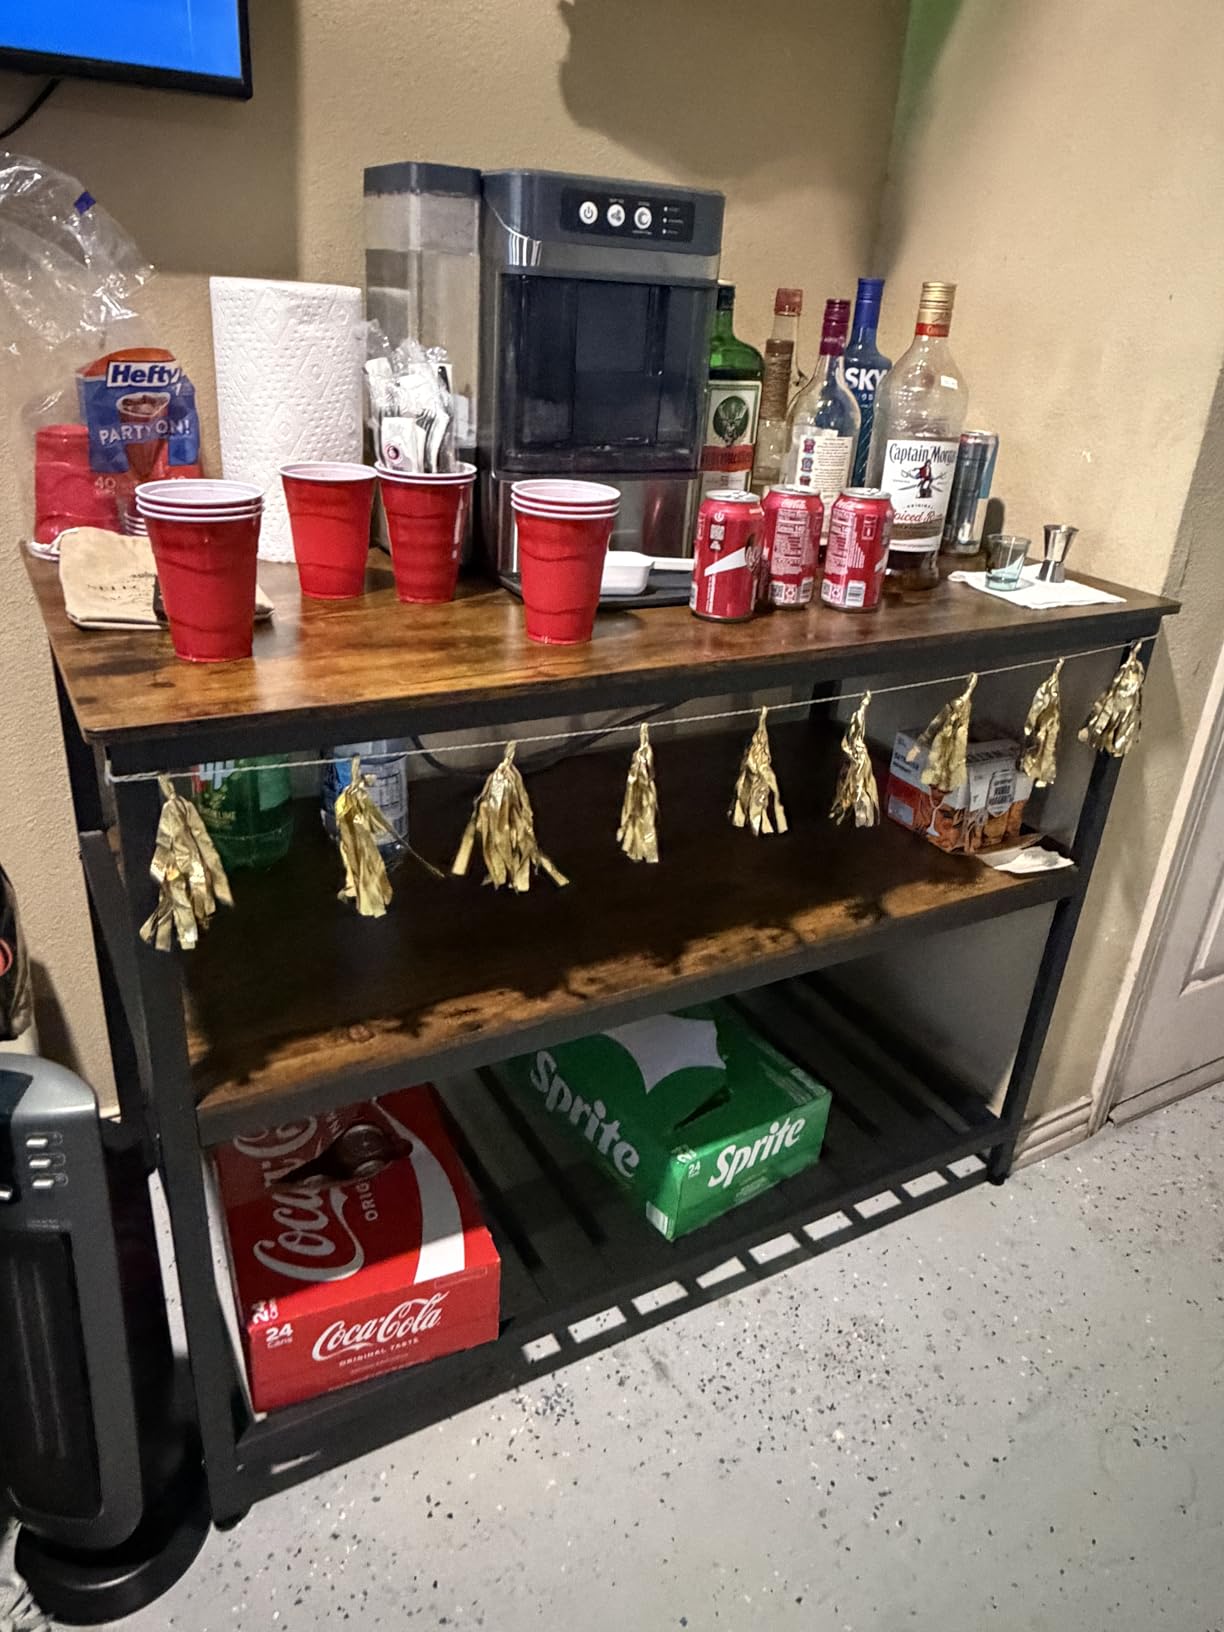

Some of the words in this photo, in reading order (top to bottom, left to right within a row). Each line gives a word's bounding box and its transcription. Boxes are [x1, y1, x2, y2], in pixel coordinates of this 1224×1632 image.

[110, 364, 177, 384] Hefty
[844, 366, 888, 391] SKY
[889, 443, 929, 465] Captain
[892, 510, 924, 523] piced
[530, 1050, 640, 1178] Sprite
[707, 1117, 805, 1189] Sprite
[265, 1322, 294, 1343] 24
[312, 1290, 449, 1361] Coca-Cola
